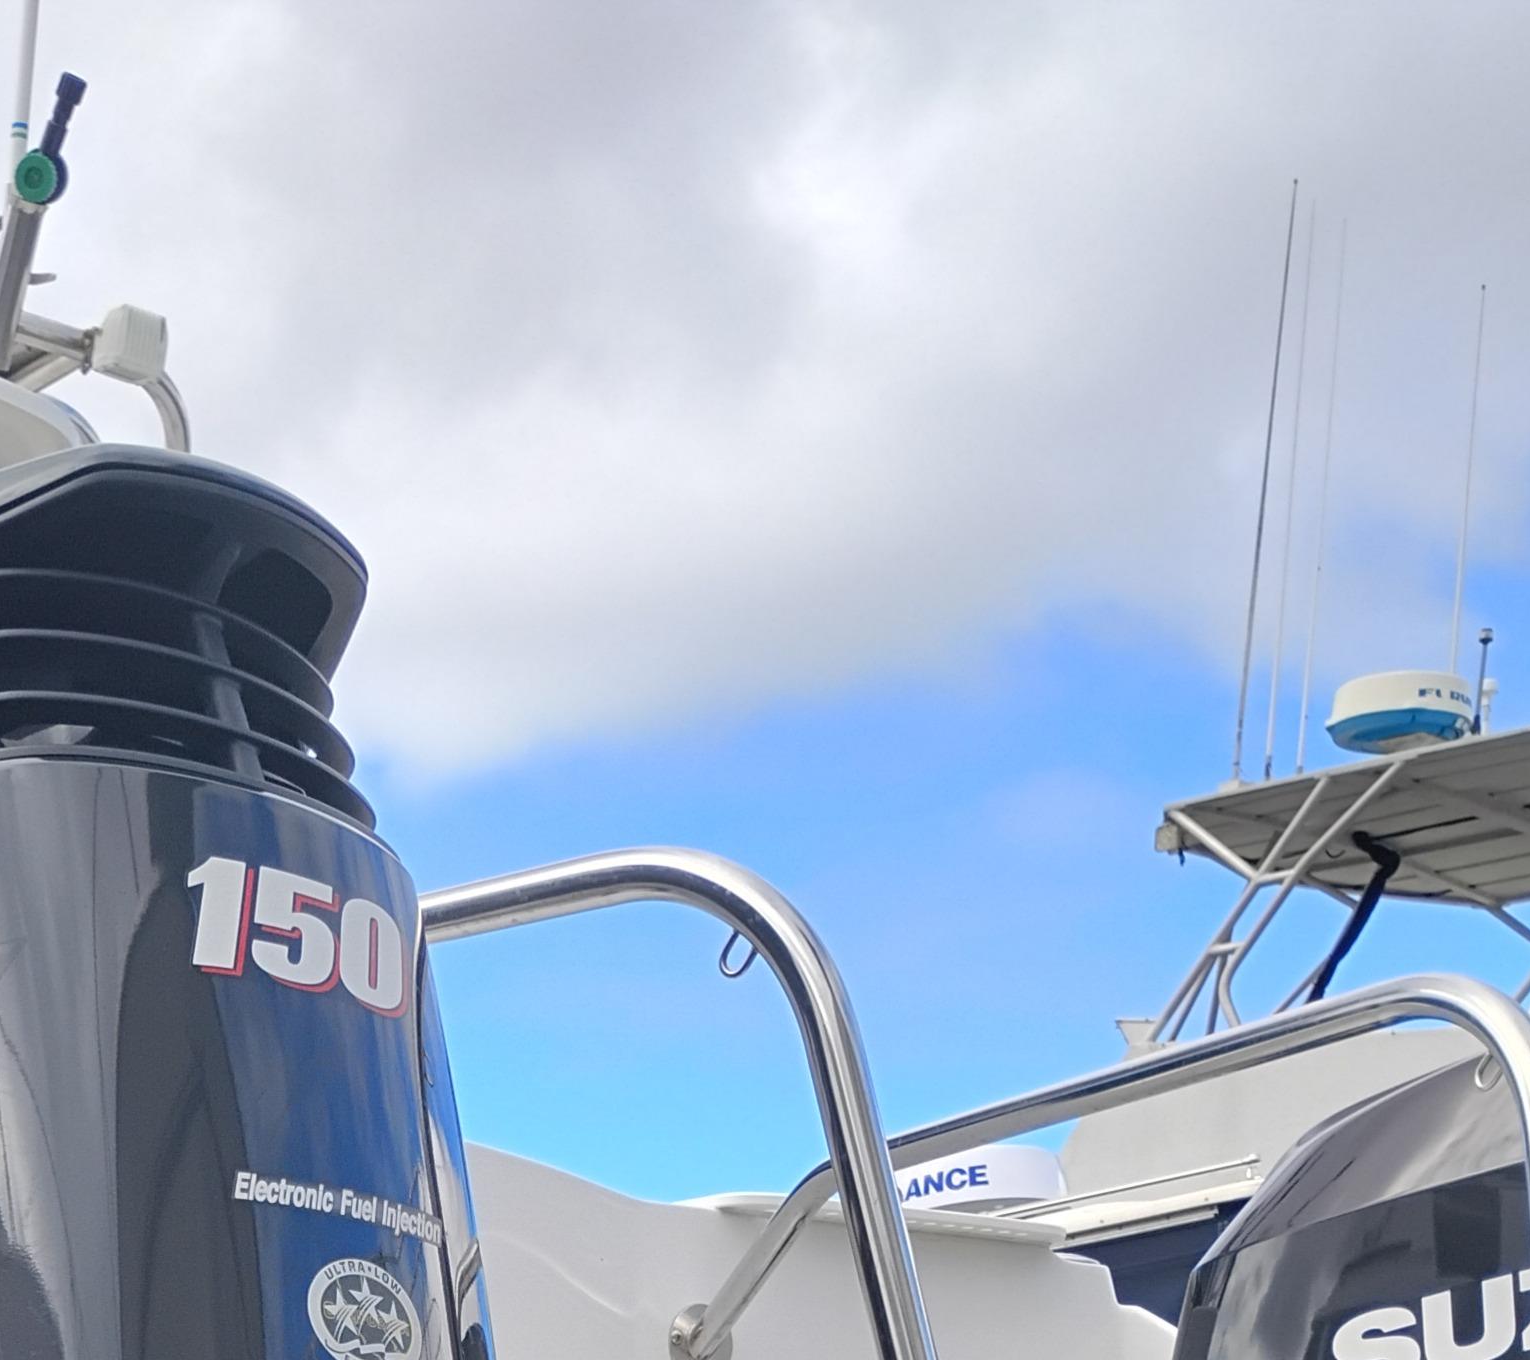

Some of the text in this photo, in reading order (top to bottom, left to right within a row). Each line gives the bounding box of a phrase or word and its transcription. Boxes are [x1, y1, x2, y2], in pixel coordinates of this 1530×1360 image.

[187, 856, 411, 1019] 150
[234, 1171, 442, 1246] Electronic Fuel Injection
